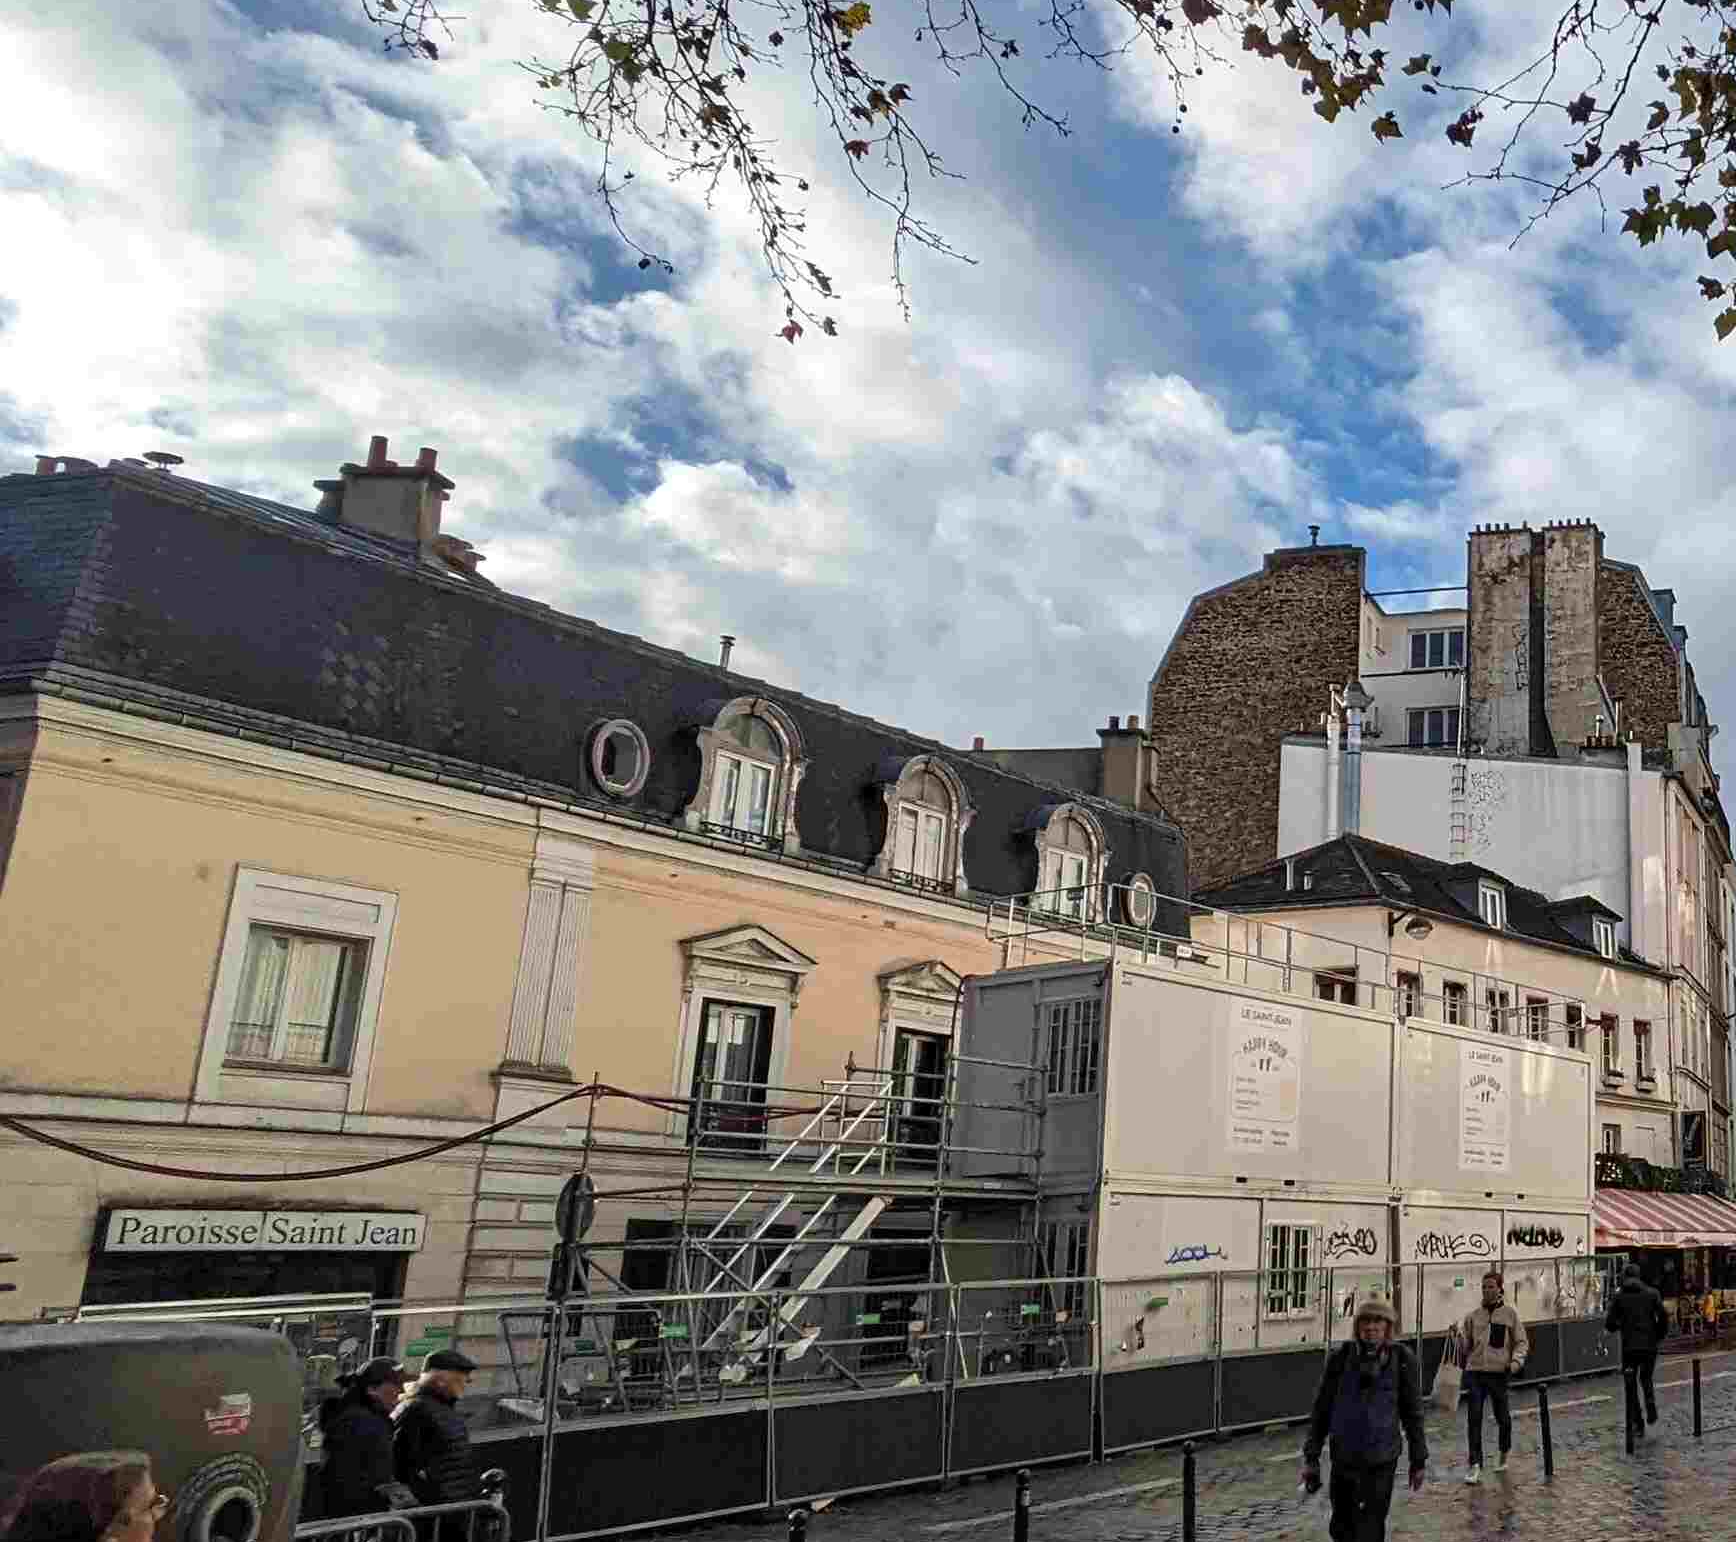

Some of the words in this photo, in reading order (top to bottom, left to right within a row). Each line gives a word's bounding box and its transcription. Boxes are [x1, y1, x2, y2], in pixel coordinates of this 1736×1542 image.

[117, 1215, 258, 1245] Paroisse
[267, 1216, 347, 1245] Saint
[354, 1218, 417, 1245] Jean
